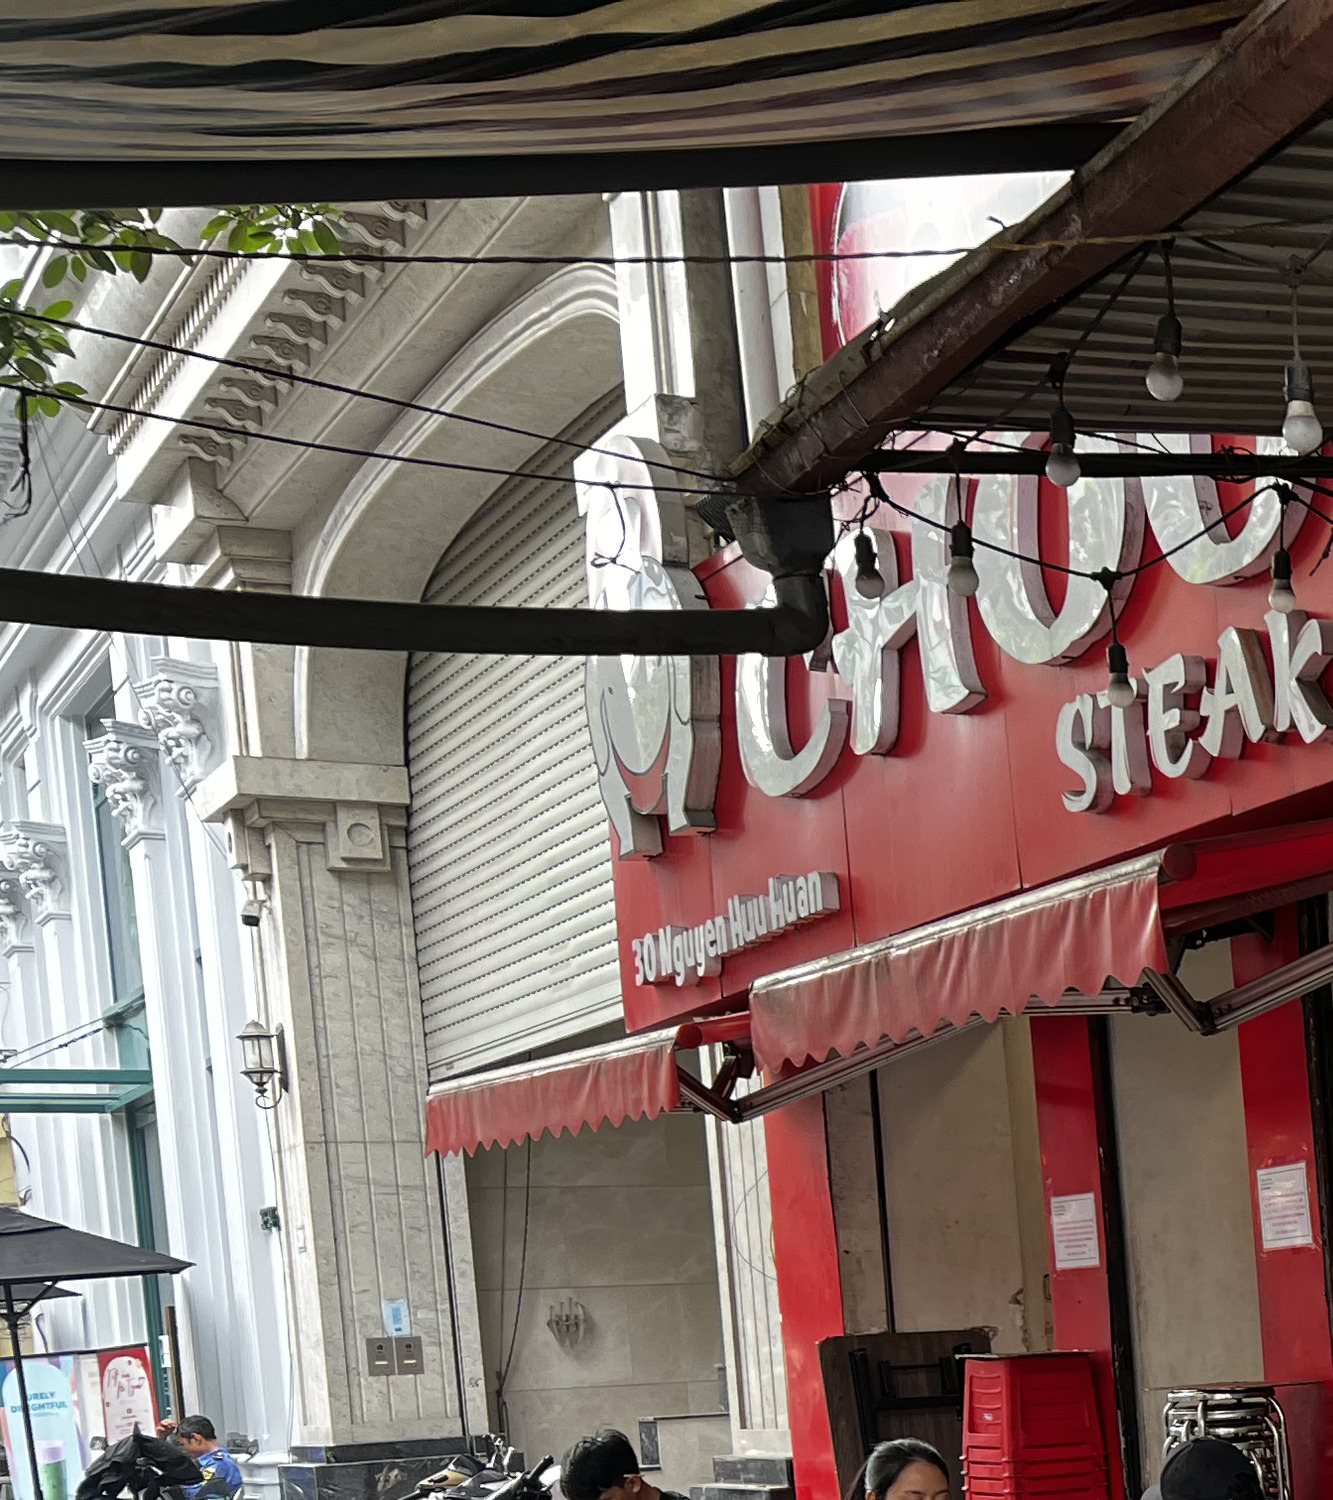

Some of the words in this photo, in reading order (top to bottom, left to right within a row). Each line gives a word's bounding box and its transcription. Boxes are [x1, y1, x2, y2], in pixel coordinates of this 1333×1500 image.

[631, 932, 656, 987] 30
[657, 915, 729, 987] Nguyen
[727, 894, 768, 949] Huu
[768, 870, 826, 931] Huan
[27, 1391, 56, 1401] URELY
